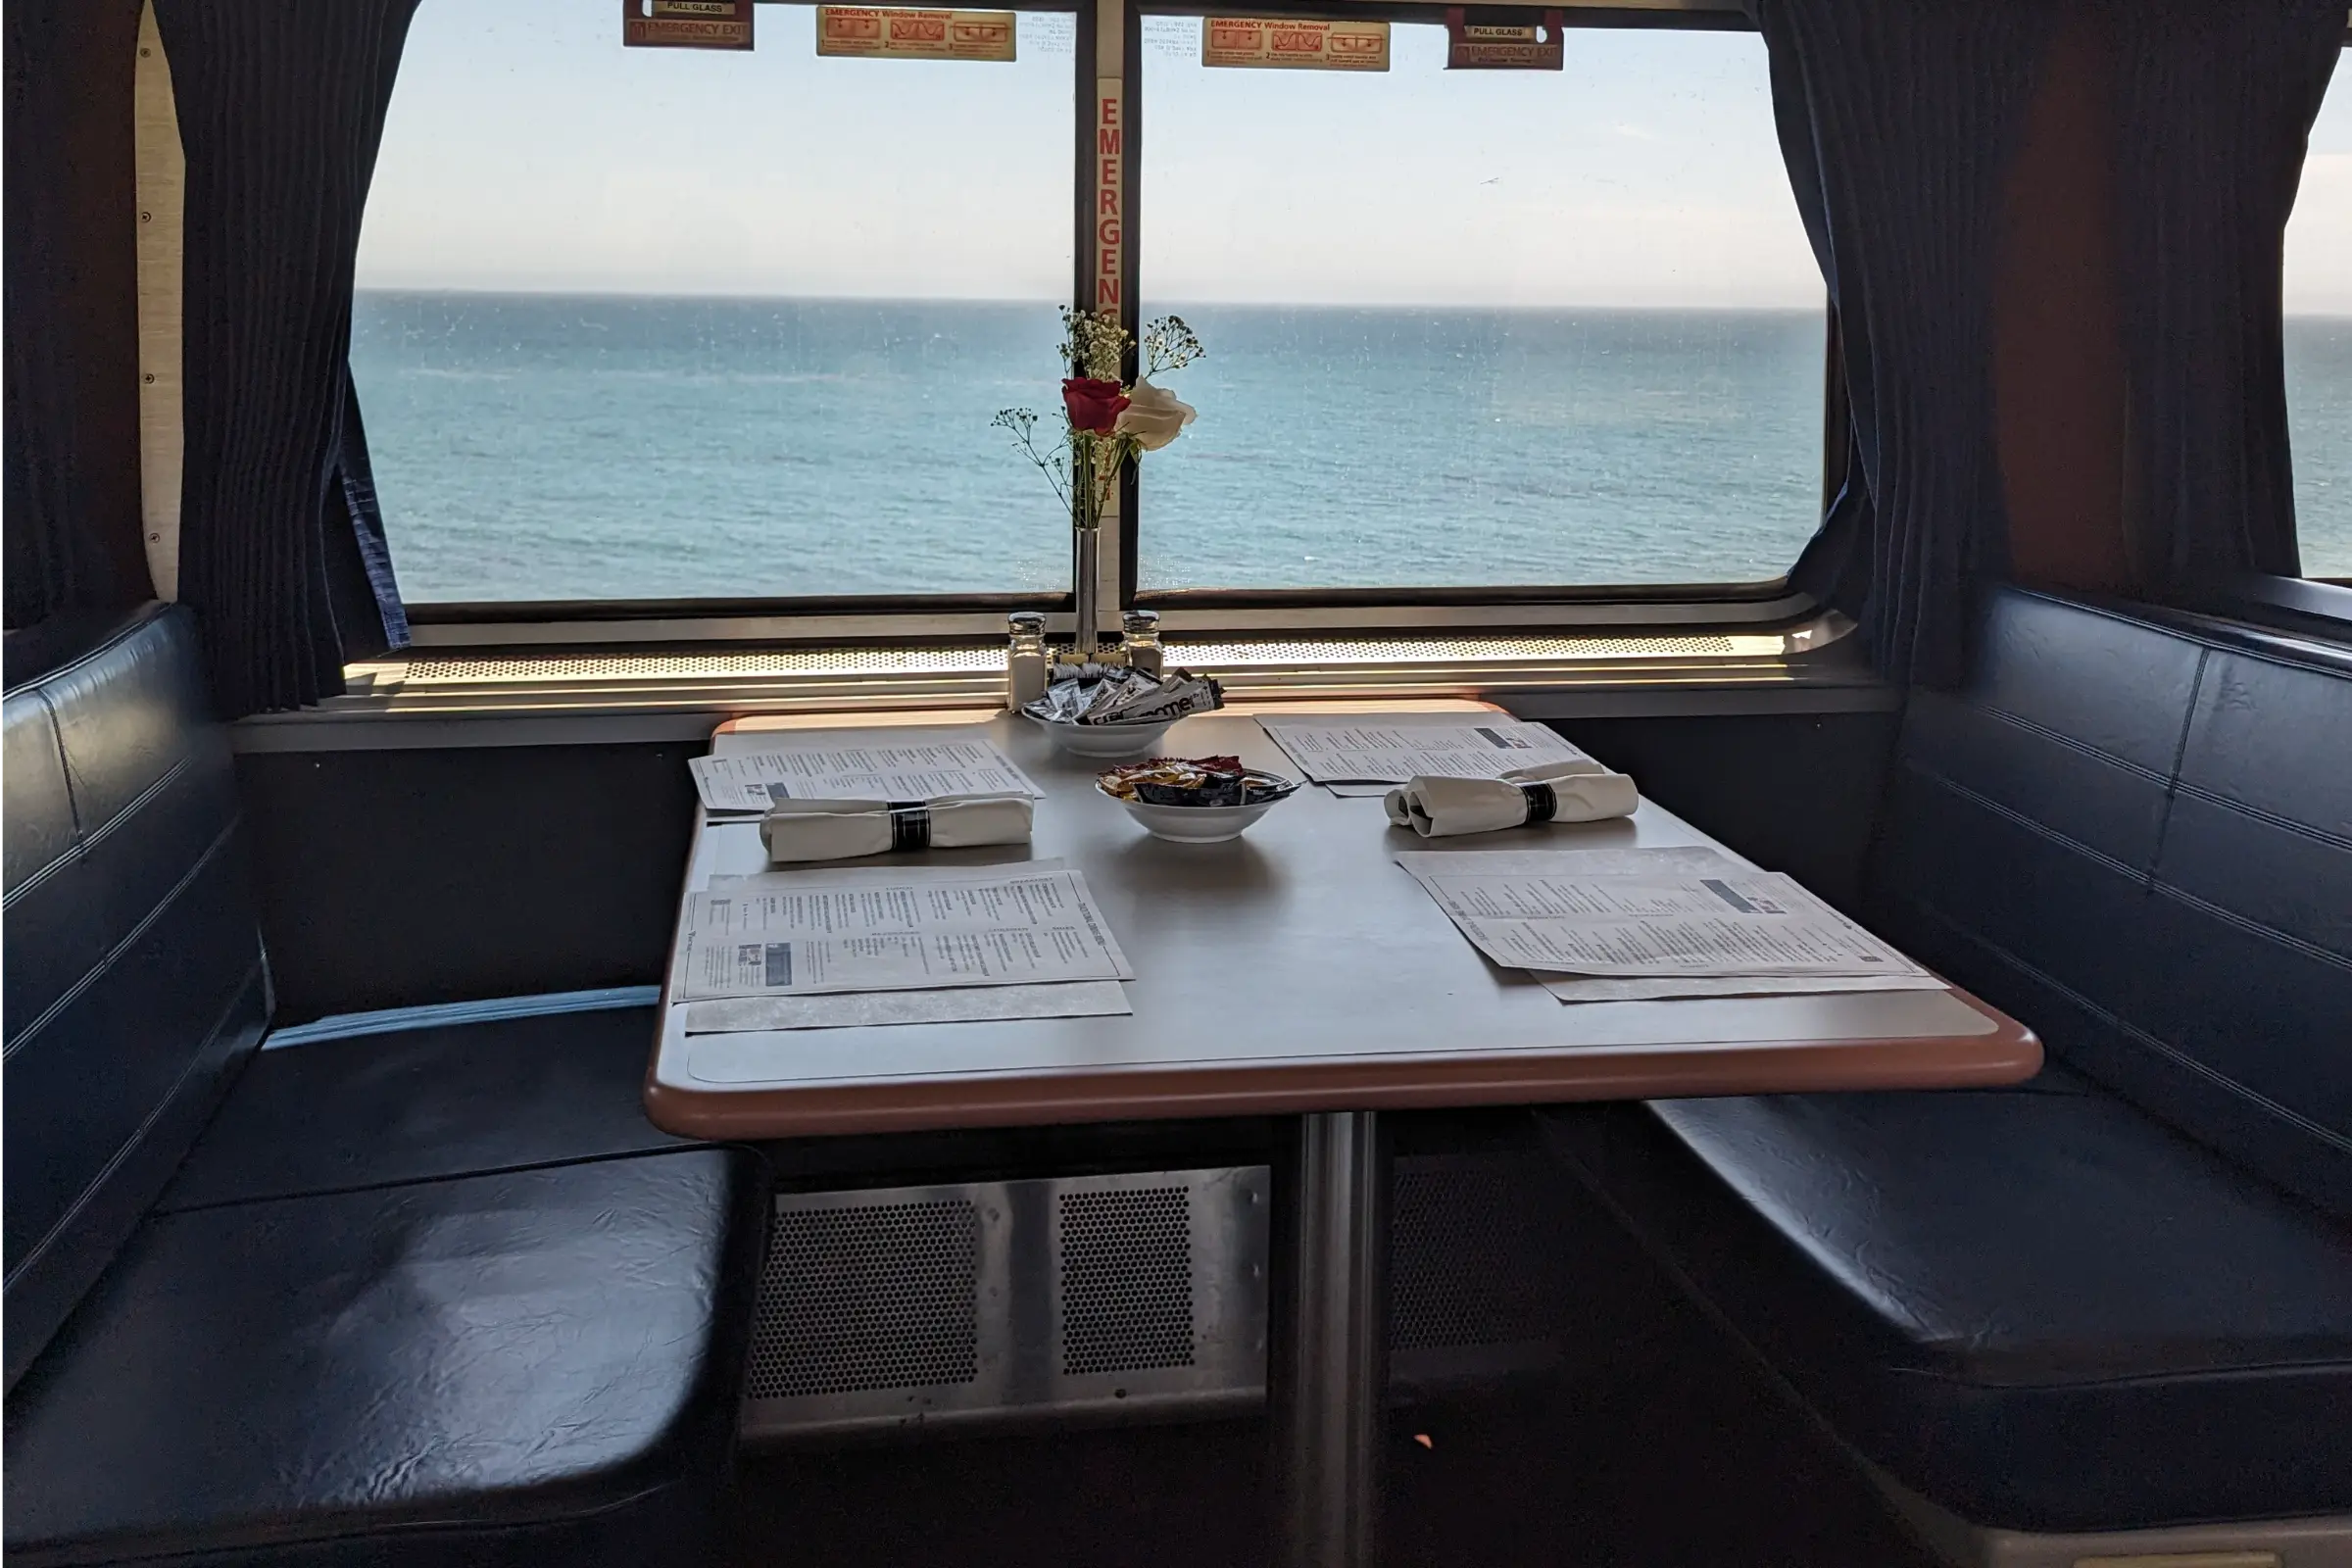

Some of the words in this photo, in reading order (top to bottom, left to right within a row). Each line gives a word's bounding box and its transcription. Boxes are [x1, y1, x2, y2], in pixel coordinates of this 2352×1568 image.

[667, 2, 690, 11] PULL
[825, 9, 880, 18] EMERGENCY
[882, 10, 916, 19] Window
[648, 22, 718, 35] EMERGENCY
[722, 24, 748, 35] EXIT
[1210, 20, 1262, 29] EMERGENCY
[1298, 23, 1330, 31] Removal
[1471, 46, 1534, 57] EMERGENCY
[1537, 47, 1557, 57] EXIT
